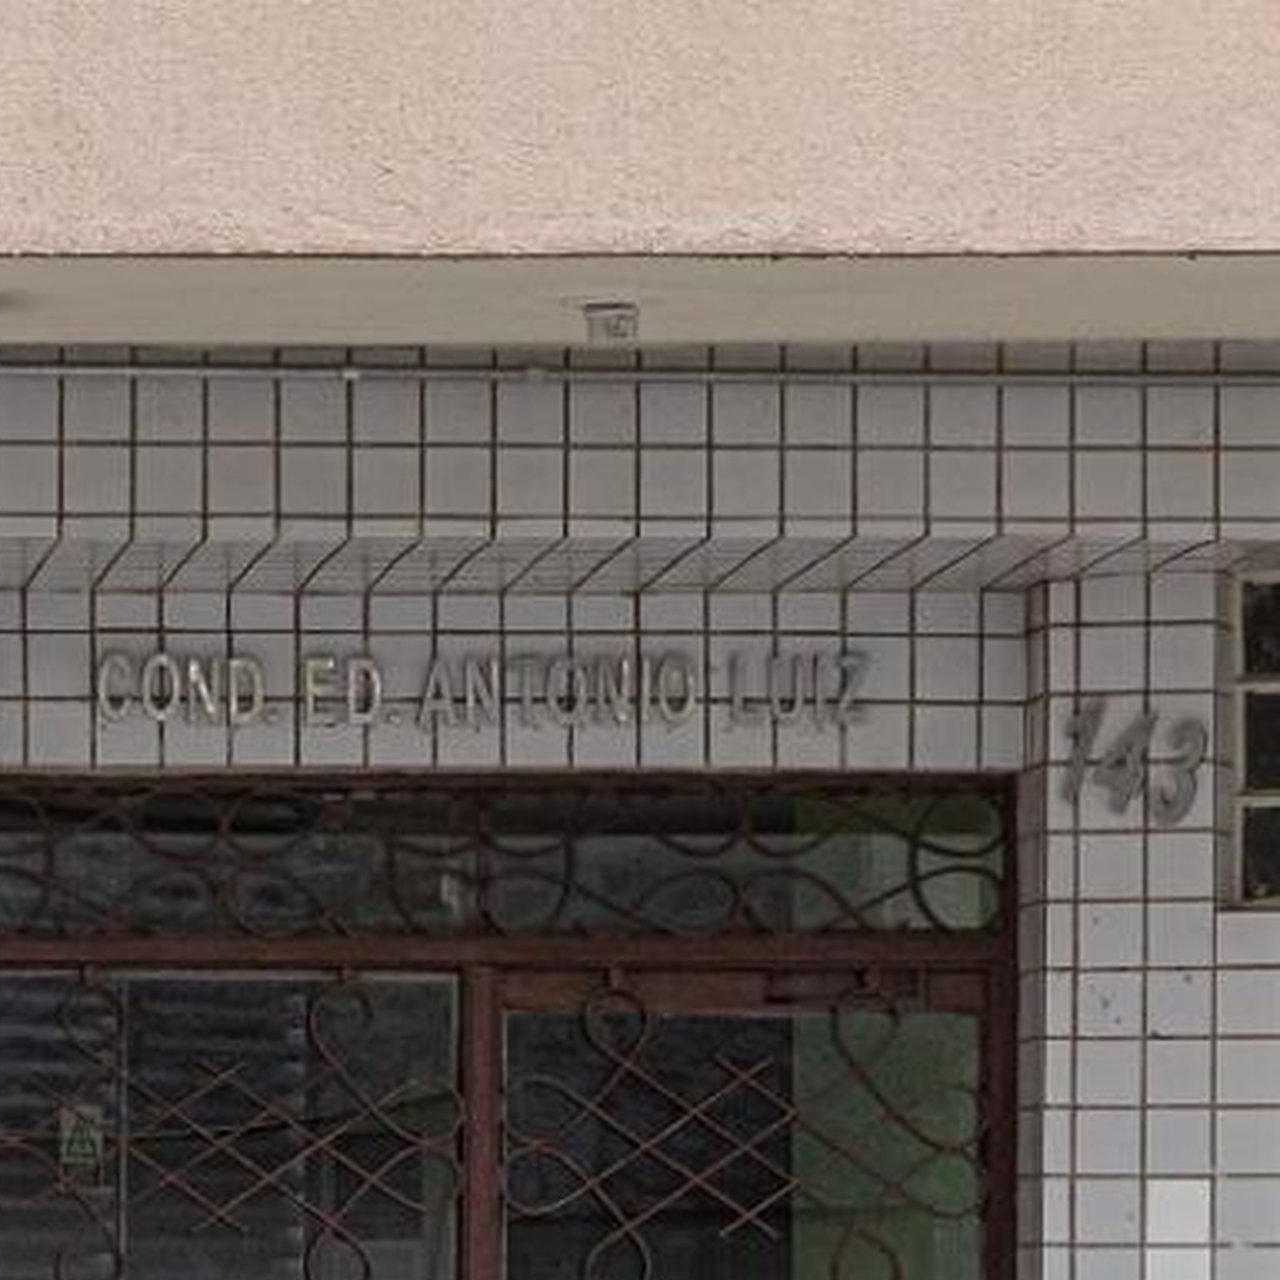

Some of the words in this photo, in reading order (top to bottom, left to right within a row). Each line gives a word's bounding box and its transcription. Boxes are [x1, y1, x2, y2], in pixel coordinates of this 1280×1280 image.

[99, 652, 278, 724] COND.
[302, 652, 402, 725] ED.
[416, 652, 696, 730] ANTONIO
[724, 650, 868, 730] LUIZ
[1058, 699, 1208, 828] 143
